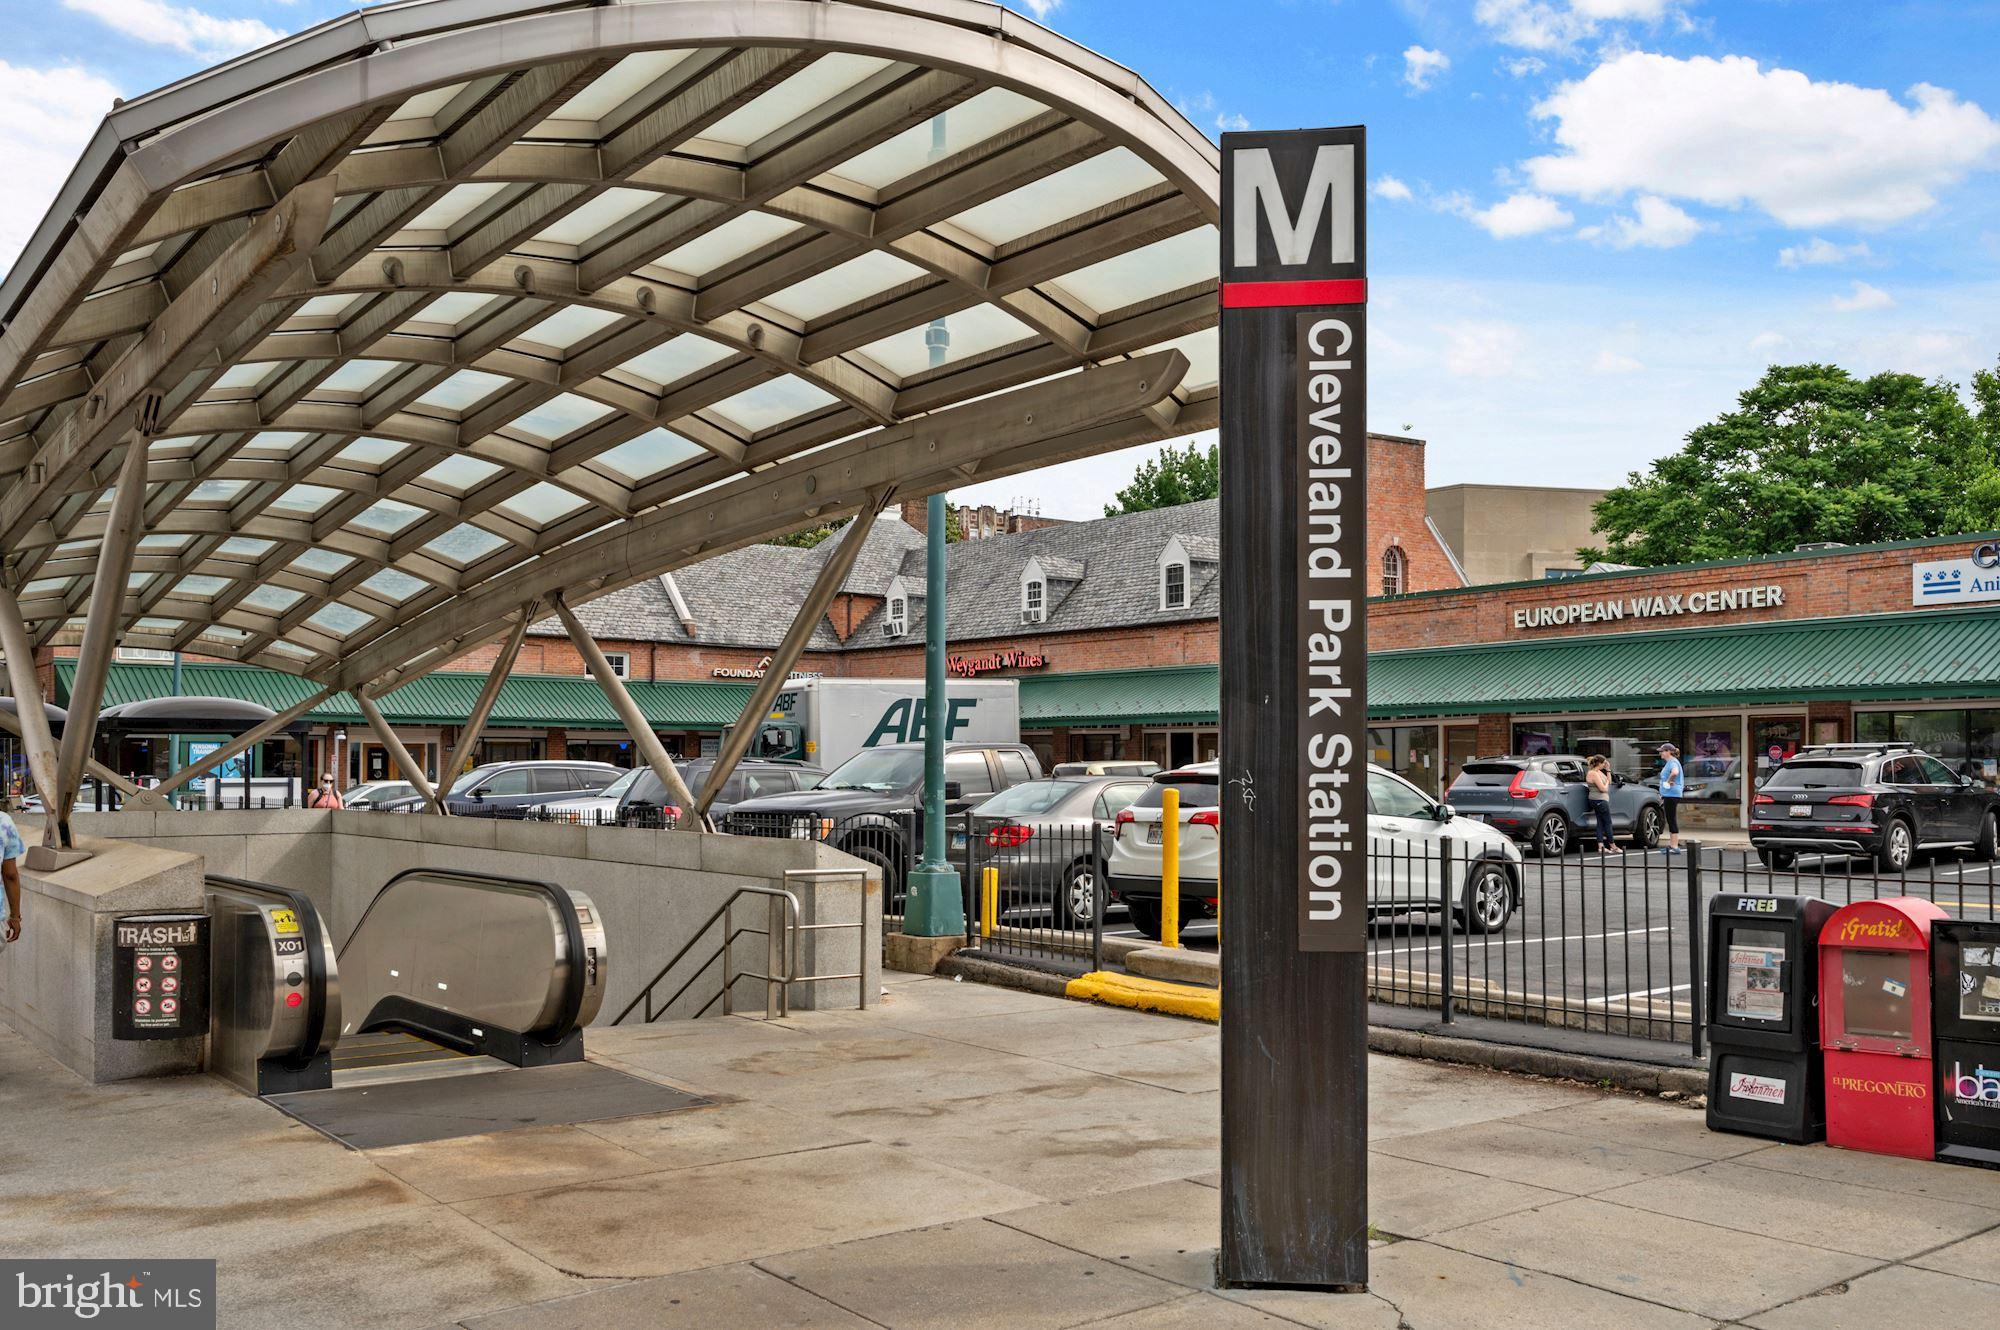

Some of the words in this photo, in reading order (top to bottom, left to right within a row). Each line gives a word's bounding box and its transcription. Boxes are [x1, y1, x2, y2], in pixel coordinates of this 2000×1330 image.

[1233, 145, 1355, 267] M
[1307, 319, 1352, 578] Cleveland
[1514, 600, 1623, 628] EUROPEAN
[1631, 593, 1684, 618] WAX
[1688, 585, 1783, 614] CENTER
[946, 655, 1002, 677] Weygandt
[1003, 650, 1043, 668] Wines
[1308, 600, 1352, 717] Park
[713, 668, 766, 679] FOUNDAT
[788, 671, 824, 679] ITNESS
[773, 692, 797, 711] ABF
[1307, 733, 1352, 920] Station
[118, 927, 182, 944] TRASH
[1841, 917, 1903, 940] ¡Gratis!
[1833, 1077, 1842, 1085] EL
[1842, 1078, 1926, 1098] PREGONERO
